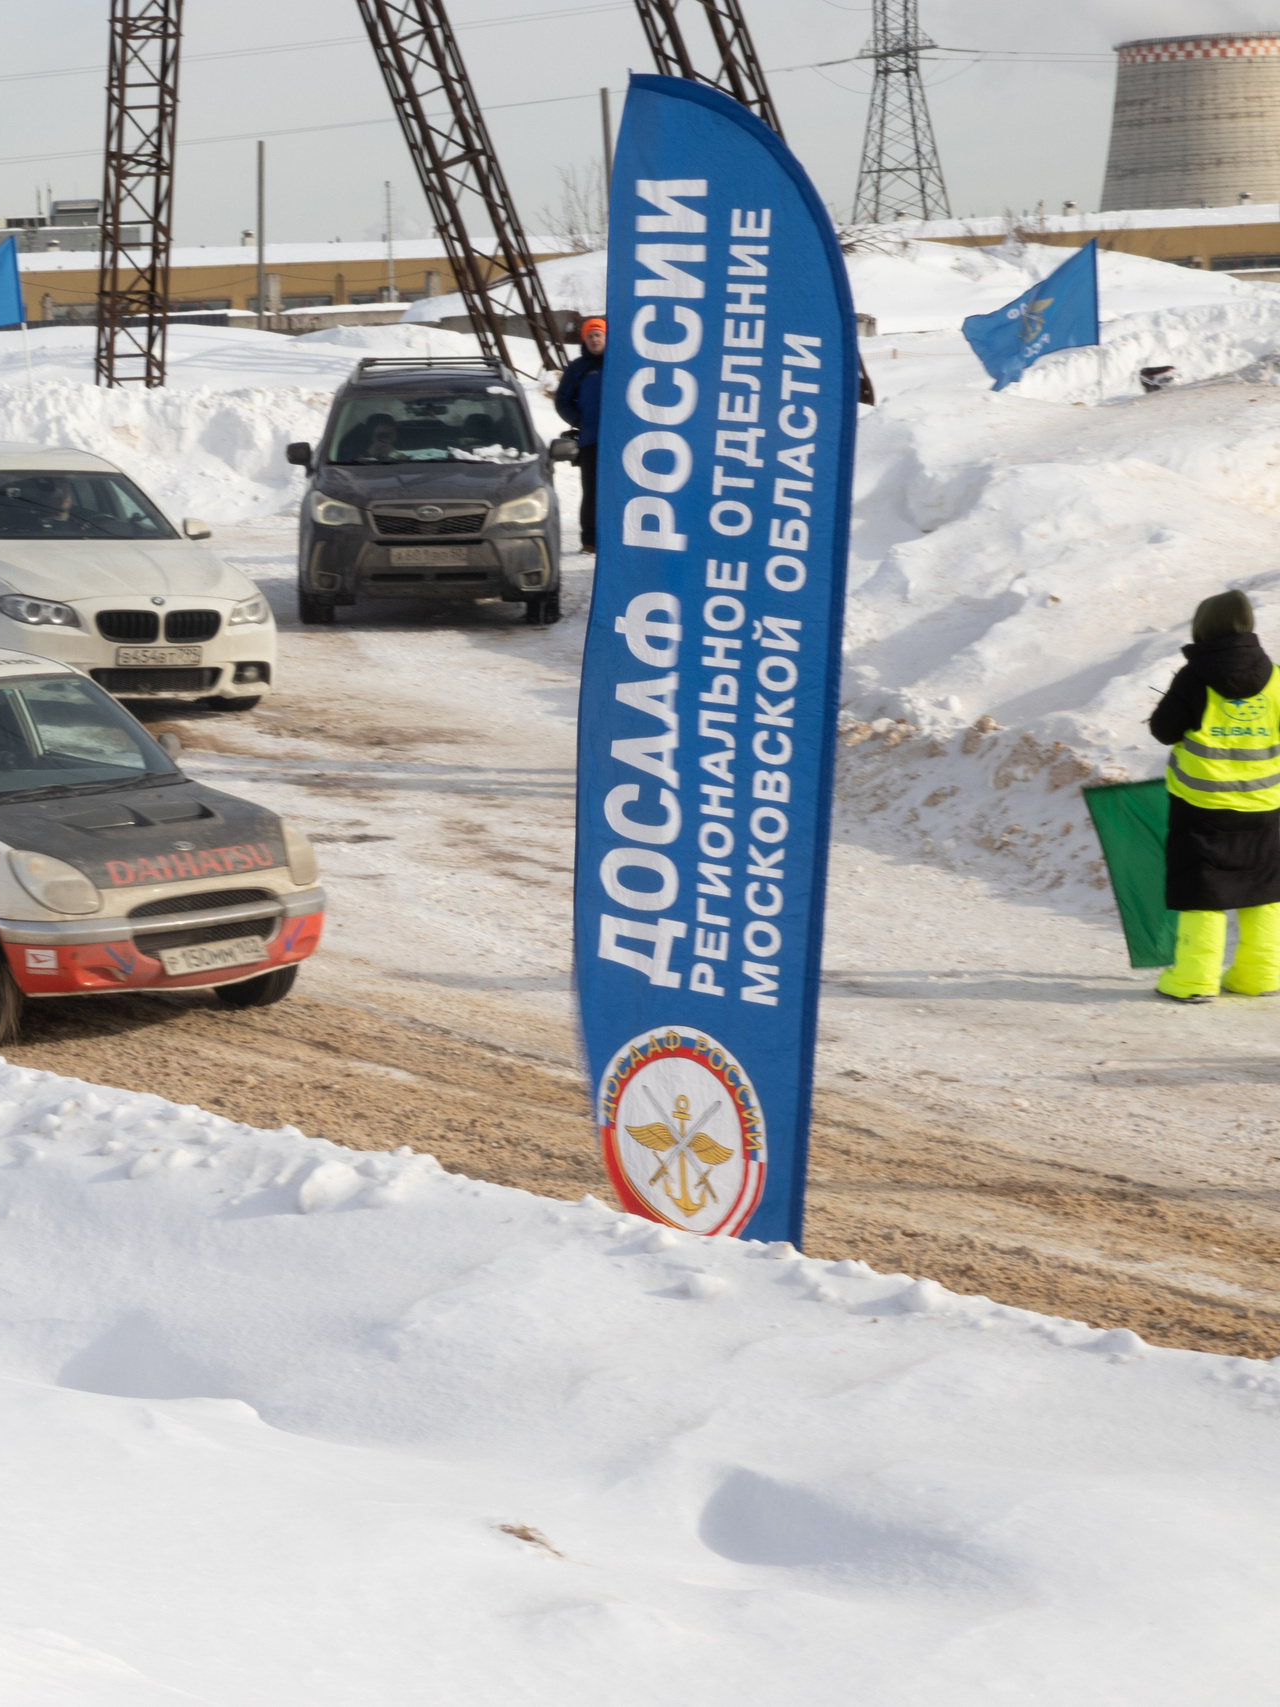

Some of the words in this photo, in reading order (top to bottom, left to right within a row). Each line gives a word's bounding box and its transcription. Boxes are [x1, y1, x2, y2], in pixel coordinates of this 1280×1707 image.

[622, 179, 708, 551] РОССИИ
[709, 208, 771, 536] ОТДЕЛЕНИЕ
[765, 333, 821, 592] ОБЛАСТИ
[104, 843, 273, 885] DAIHATSU
[597, 591, 687, 988] ДОСААФ
[689, 559, 748, 996] РЕГИОНАЛЬНОЕ
[740, 616, 802, 1006] МОСКОВСКОЙ
[600, 1029, 682, 1124] ДОСААФ
[692, 1034, 763, 1151] РОССИИ
